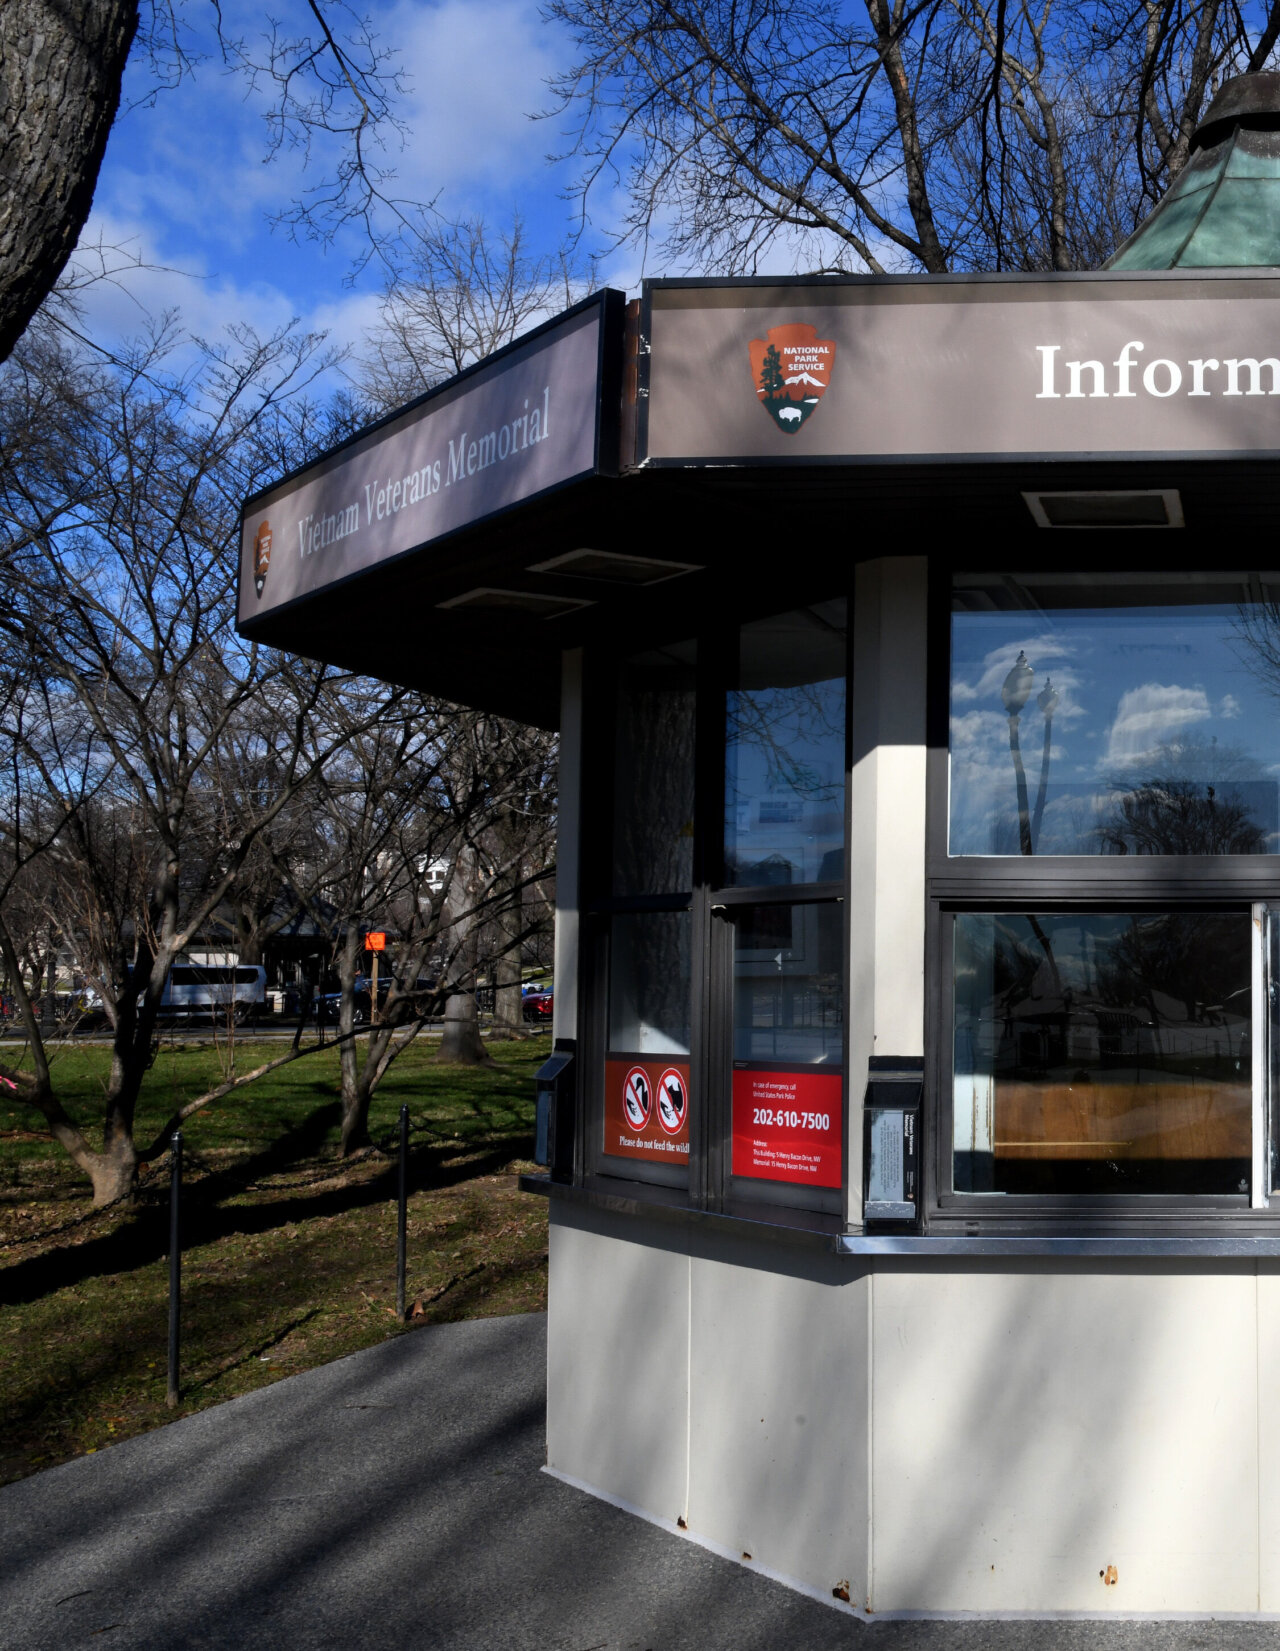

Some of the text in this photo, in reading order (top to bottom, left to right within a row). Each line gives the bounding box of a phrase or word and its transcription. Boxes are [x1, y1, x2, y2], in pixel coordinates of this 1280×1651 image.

[298, 386, 549, 559] Vietnam Veterans Memorial
[753, 1108, 830, 1130] 202-610-7500
[619, 1136, 690, 1153] Please do not feed the wildl
